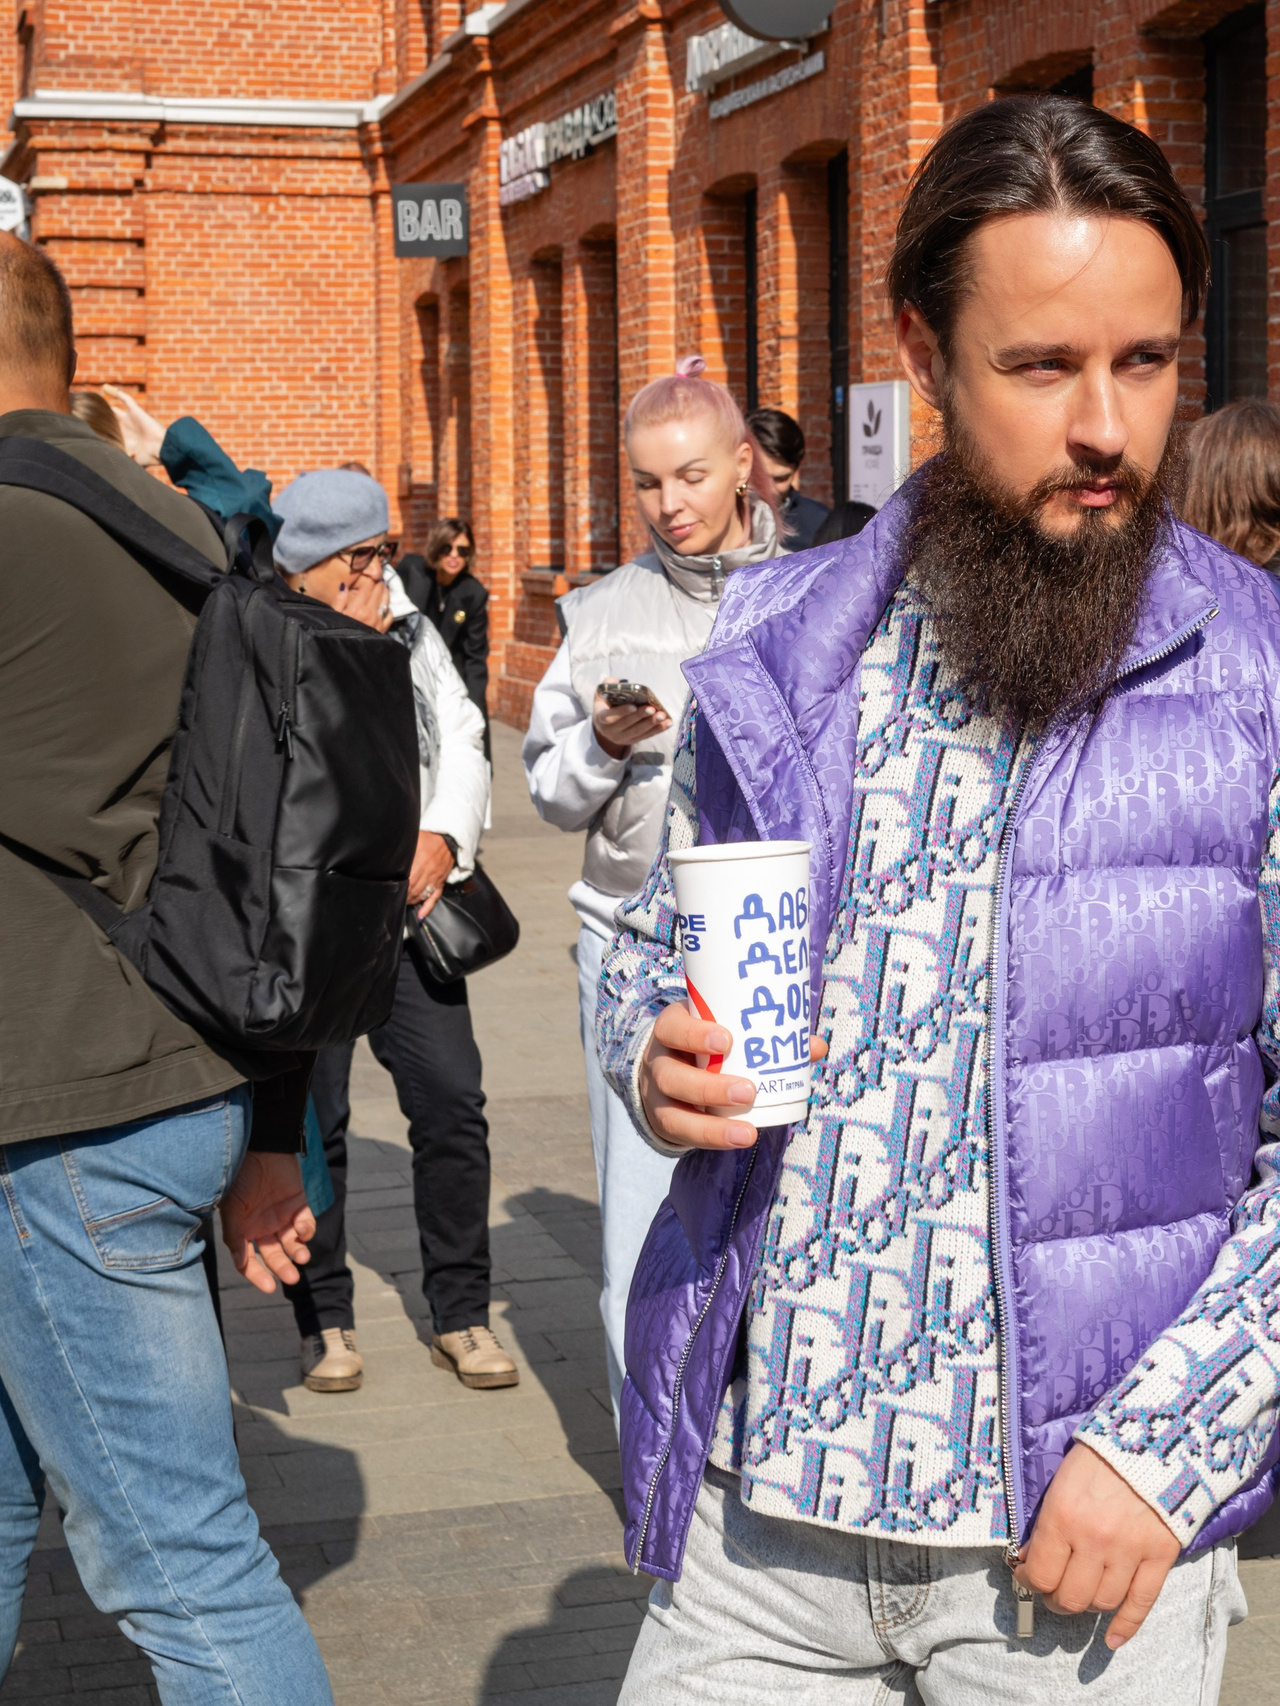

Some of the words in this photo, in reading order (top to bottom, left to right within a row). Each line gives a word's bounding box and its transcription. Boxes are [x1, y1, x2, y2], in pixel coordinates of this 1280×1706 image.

[397, 198, 463, 242] BAR
[734, 887, 809, 939] ДАВ
[744, 1026, 809, 1068] ВМЕ
